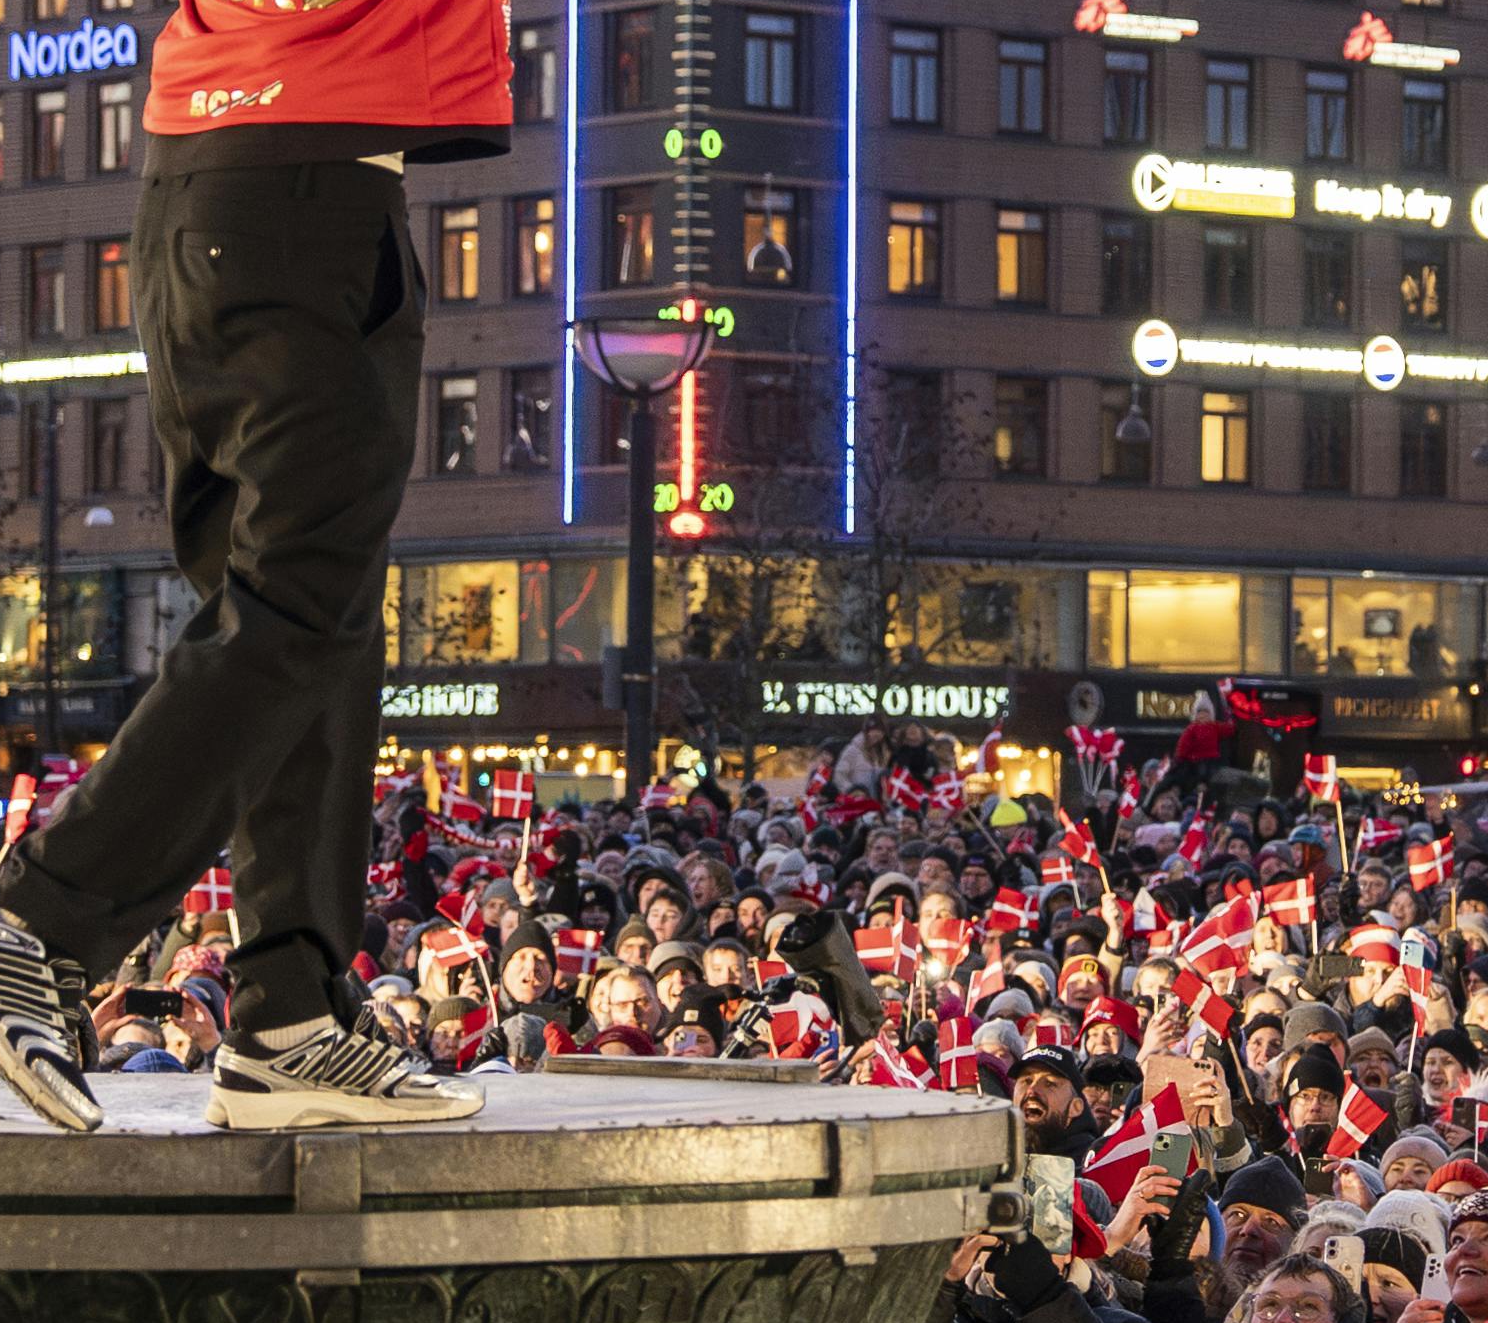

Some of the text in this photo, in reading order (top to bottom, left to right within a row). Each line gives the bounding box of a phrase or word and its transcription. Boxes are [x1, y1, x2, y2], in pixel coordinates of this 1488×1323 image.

[10, 17, 139, 81] Nordea
[665, 129, 683, 158] 0
[700, 129, 723, 159] 0
[700, 483, 734, 512] 20
[911, 684, 1009, 719] HOU
[1021, 1048, 1063, 1062] adidas
